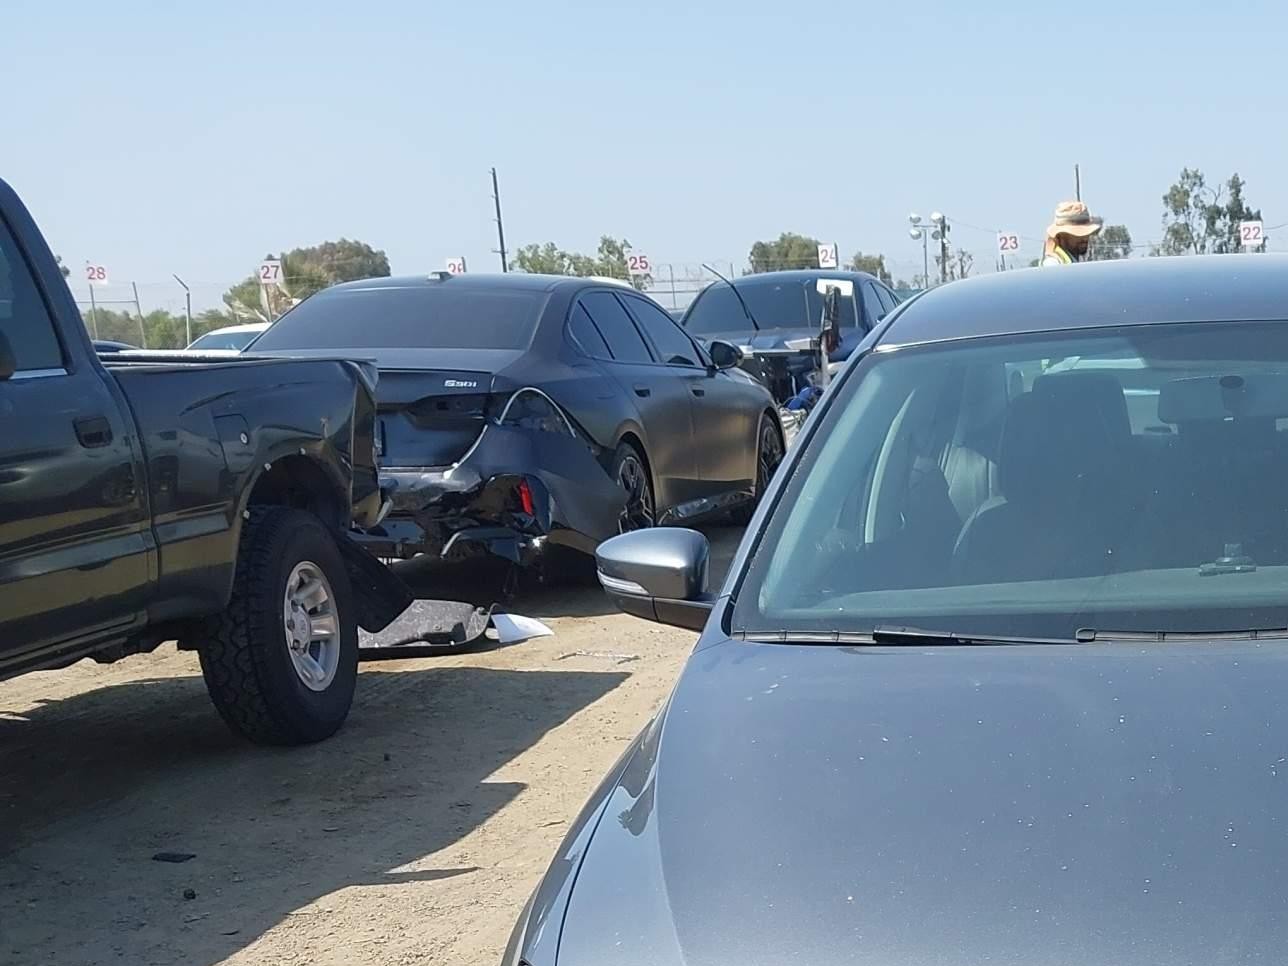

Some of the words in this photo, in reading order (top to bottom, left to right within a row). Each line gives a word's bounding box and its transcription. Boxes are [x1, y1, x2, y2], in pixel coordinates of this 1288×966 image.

[1242, 226, 1261, 240] 22
[1000, 235, 1018, 250] 23
[629, 255, 649, 270] 25
[820, 248, 836, 263] 24
[86, 266, 106, 280] 28
[261, 264, 280, 279] 27
